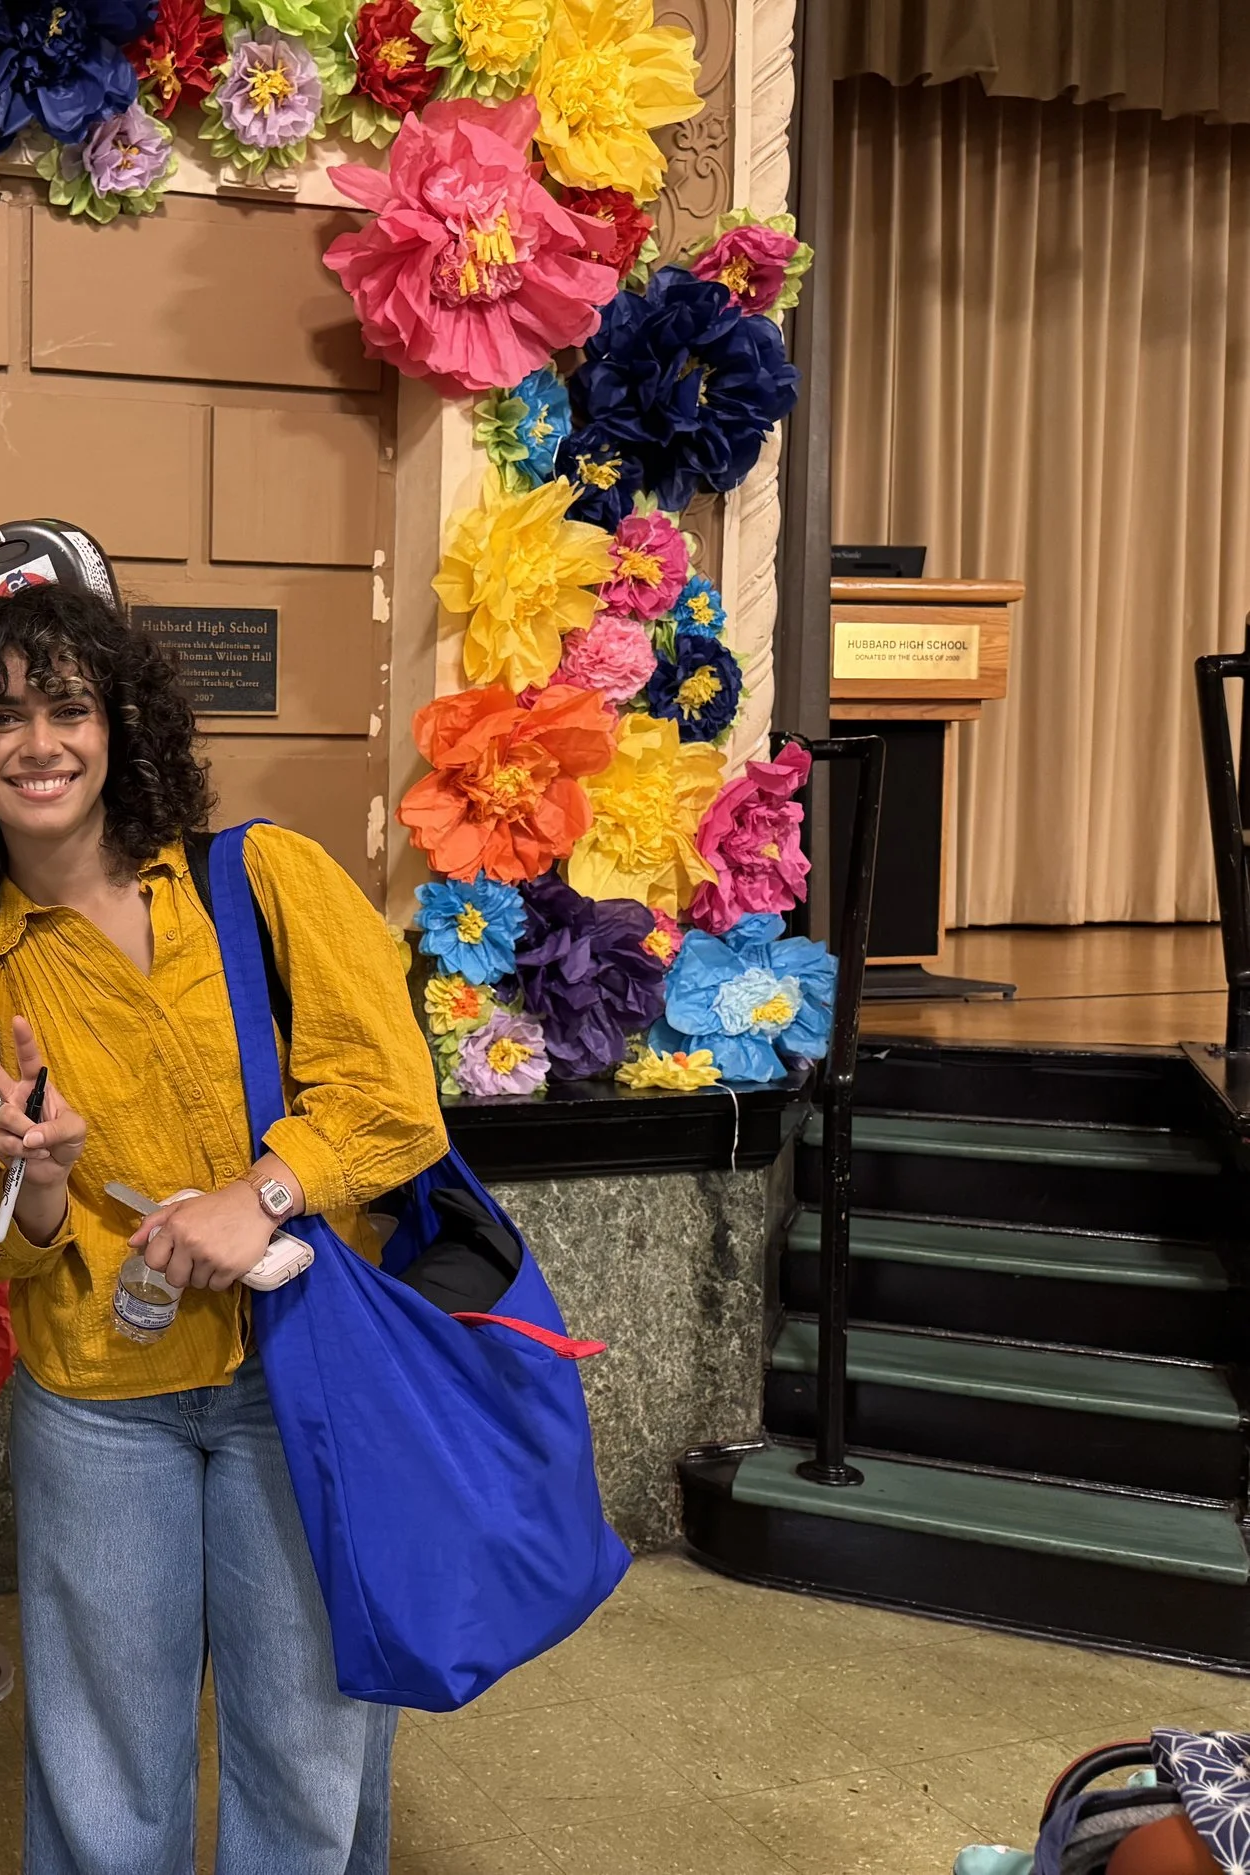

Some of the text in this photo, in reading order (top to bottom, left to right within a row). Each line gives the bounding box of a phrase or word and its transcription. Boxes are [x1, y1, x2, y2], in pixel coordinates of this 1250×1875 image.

[142, 620, 268, 636] Hubbard High School
[193, 641, 207, 649] this
[209, 641, 251, 650] Auditorium
[847, 640, 968, 650] HUBBARD HIGH SCHOOL
[178, 651, 213, 661] Thomas
[216, 651, 248, 662] Wilson
[252, 652, 272, 662] Hall
[221, 669, 230, 677] of
[231, 669, 242, 677] his
[202, 679, 235, 688] Teaching
[194, 694, 214, 702] 2007
[1, 1165, 18, 1206] Sharpie
